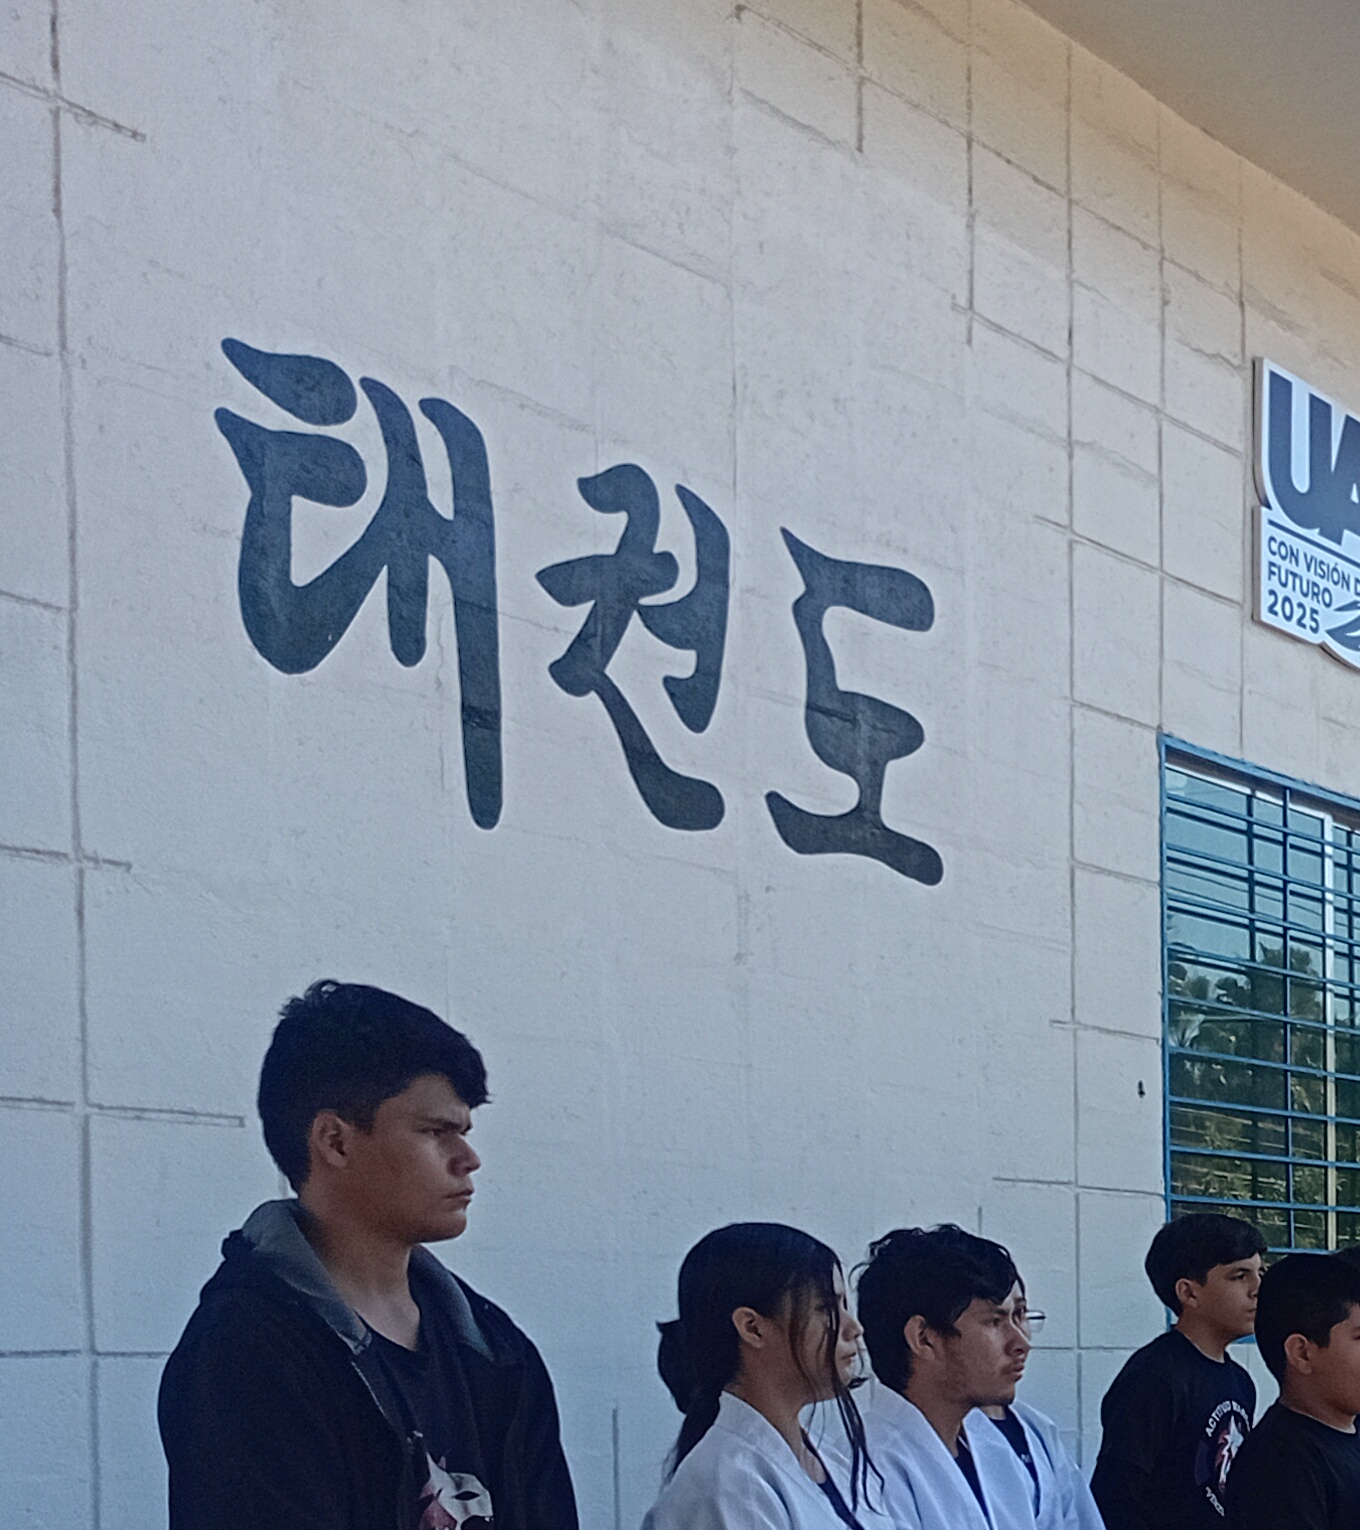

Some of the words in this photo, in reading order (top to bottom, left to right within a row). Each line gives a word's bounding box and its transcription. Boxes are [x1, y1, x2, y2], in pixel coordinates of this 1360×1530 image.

[1267, 535, 1299, 567] CON
[1303, 551, 1351, 591] VISIÓN
[1267, 565, 1333, 608] FUTURO
[212, 336, 944, 887] 태권도
[1267, 590, 1320, 635] 2025
